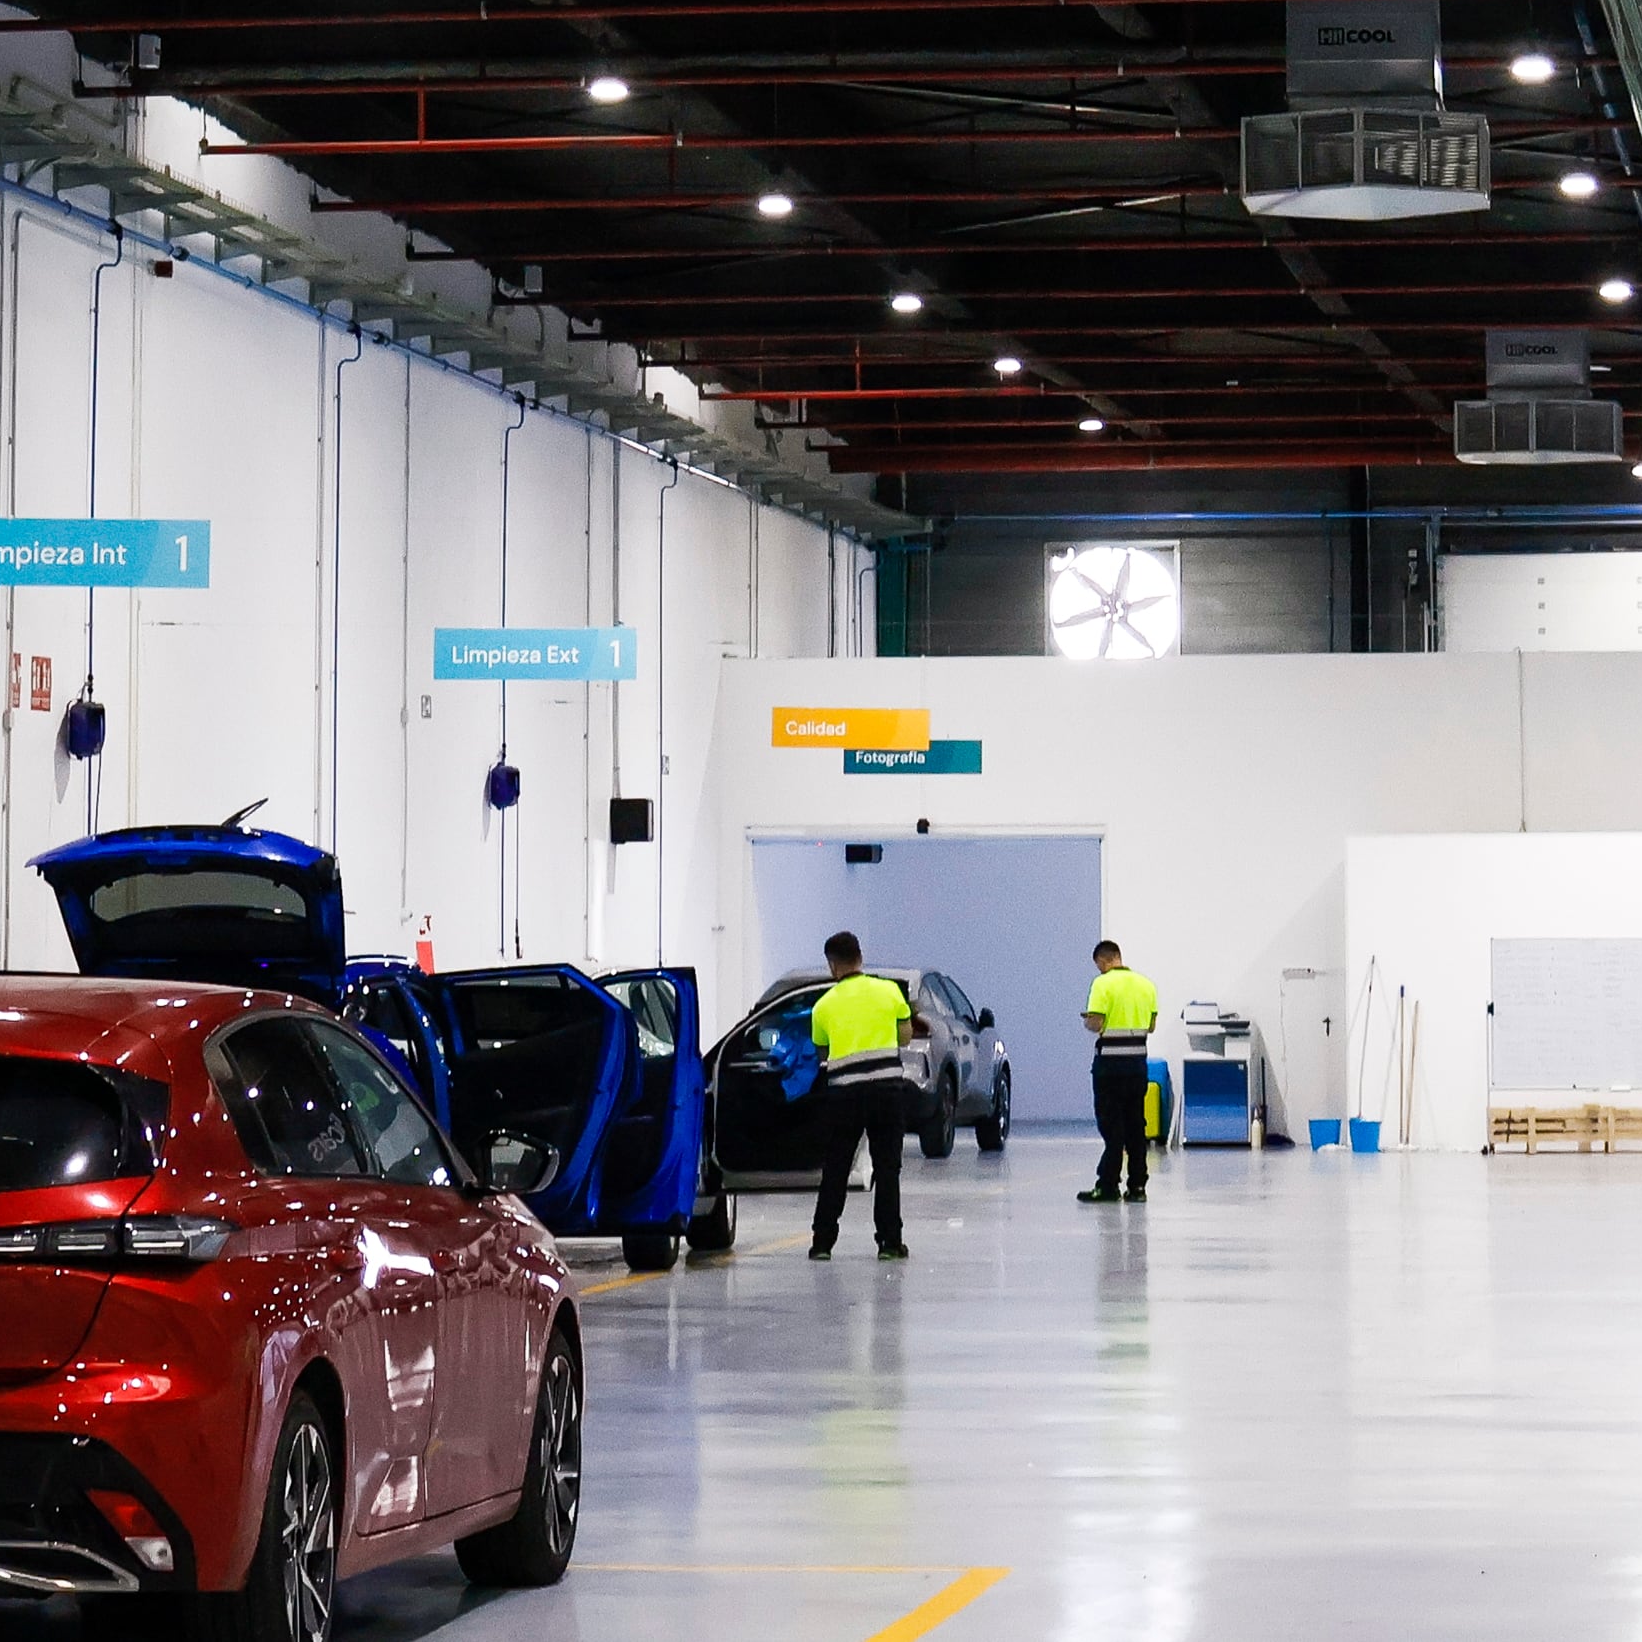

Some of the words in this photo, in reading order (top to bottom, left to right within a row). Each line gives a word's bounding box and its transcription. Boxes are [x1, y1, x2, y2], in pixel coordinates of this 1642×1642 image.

[93, 542, 127, 565] Int
[174, 535, 189, 572] 1
[452, 645, 541, 669] Limpieza
[547, 645, 580, 664] Ext
[609, 640, 620, 668] 1
[785, 720, 846, 736] Calidad
